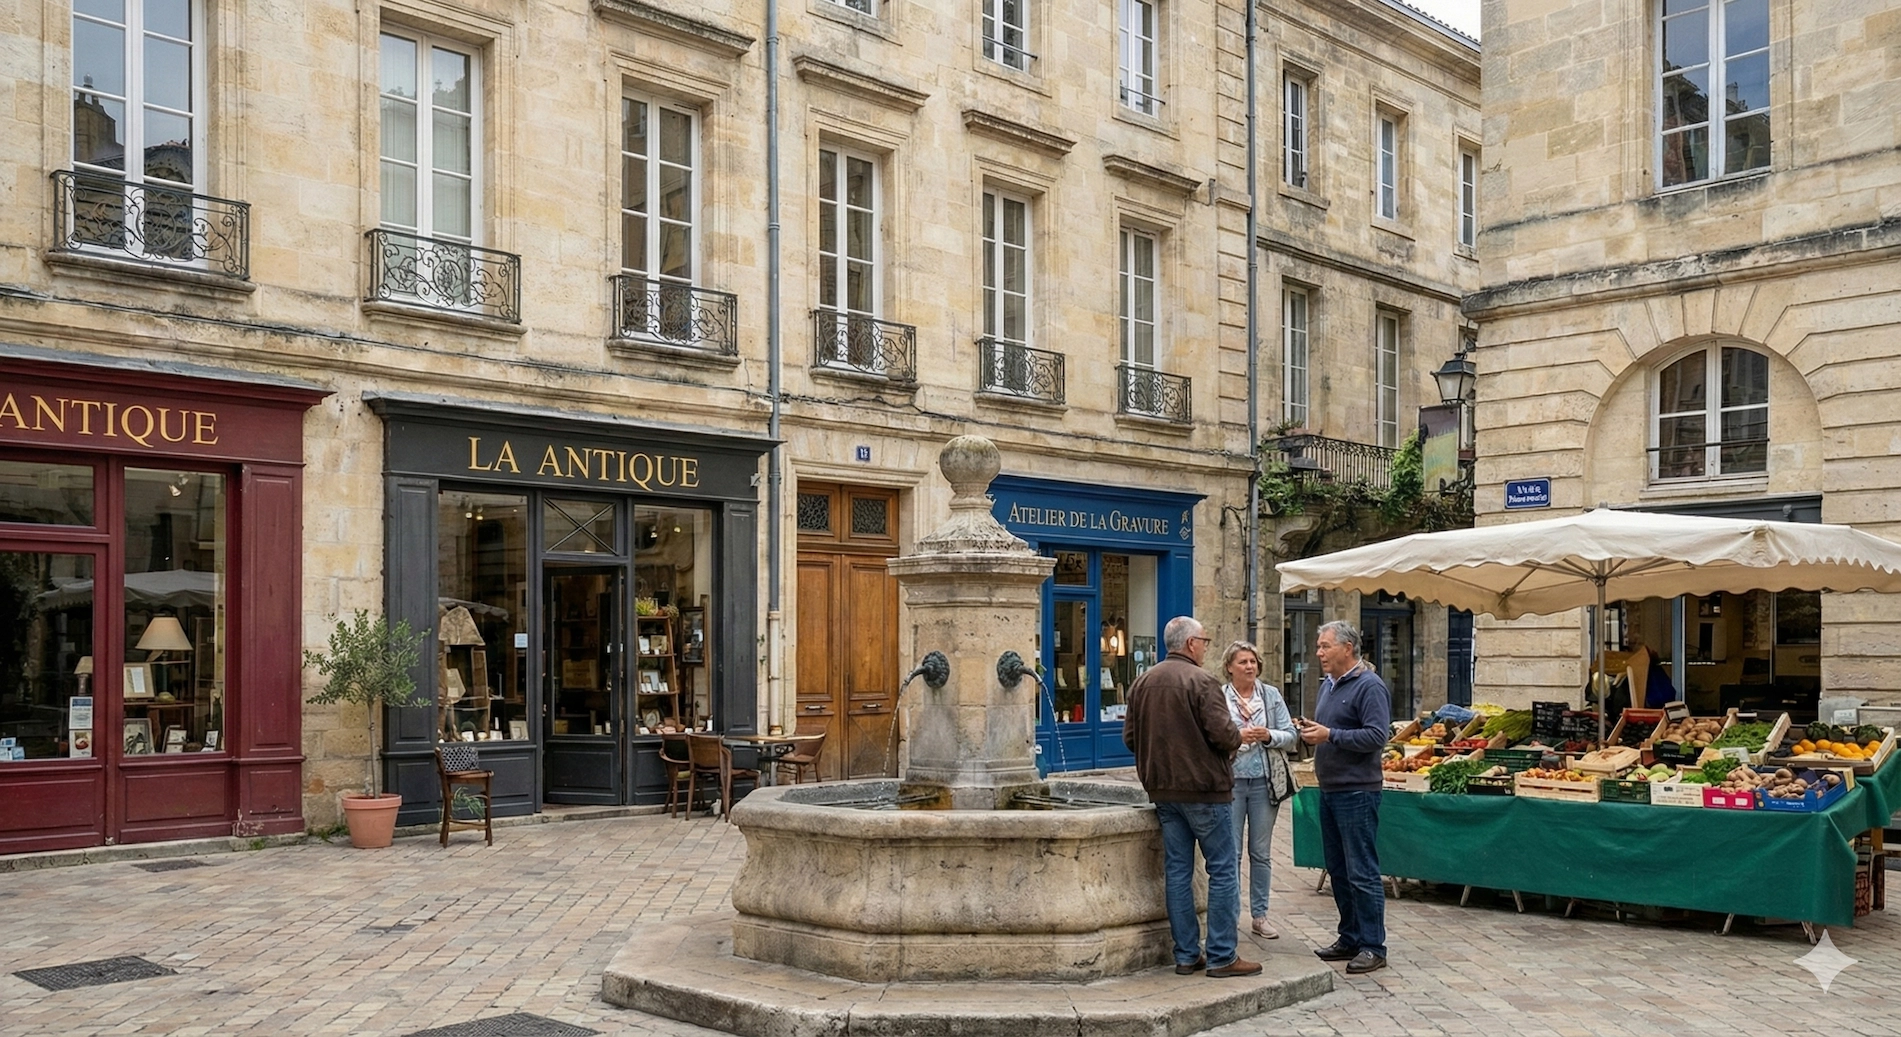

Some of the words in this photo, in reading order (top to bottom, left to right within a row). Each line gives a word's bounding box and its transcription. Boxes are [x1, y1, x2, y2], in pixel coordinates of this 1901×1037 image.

[0, 392, 219, 448] ANTIQUE
[467, 436, 521, 474] LA
[536, 444, 700, 491] ANTIQUE
[1007, 502, 1067, 527] ATELIER
[1070, 511, 1087, 528] DE
[1090, 513, 1107, 530] LA
[1109, 510, 1169, 535] GRAVURE
